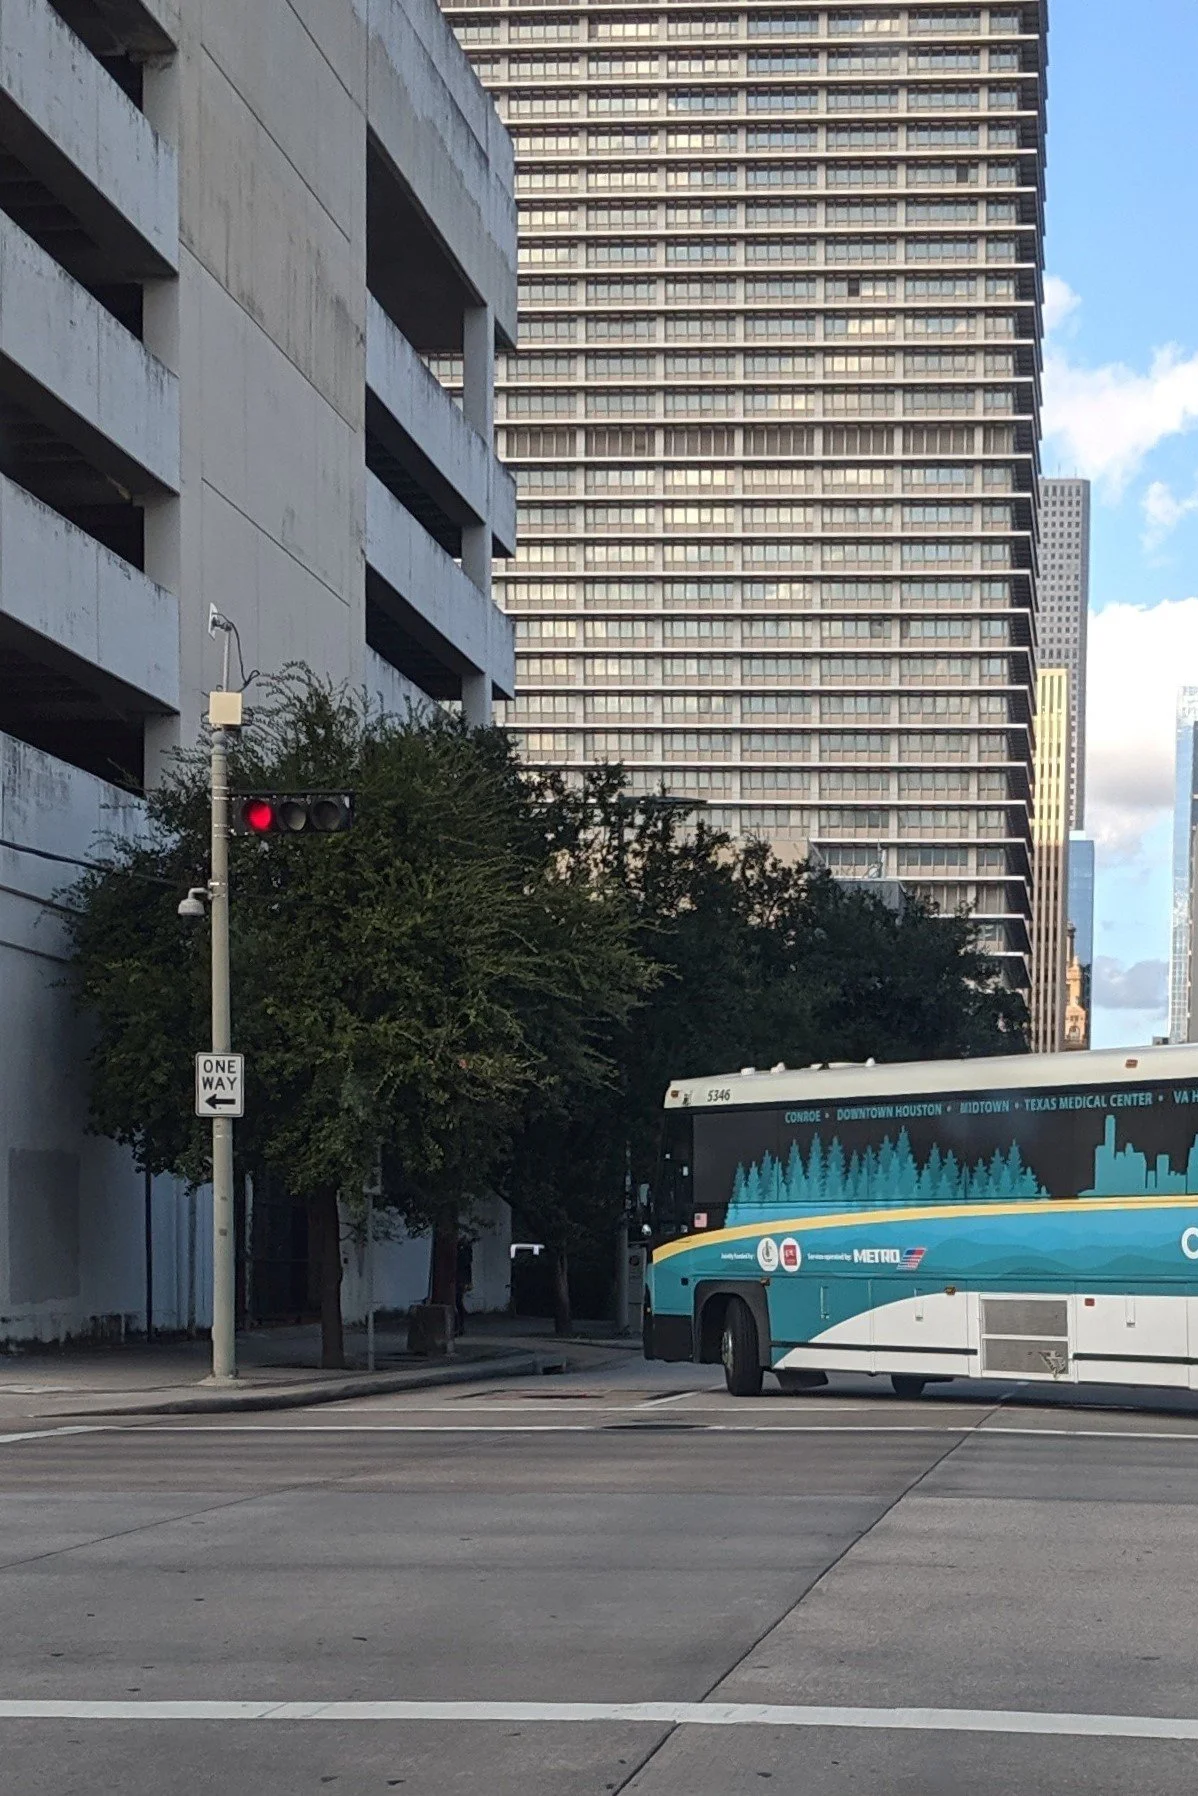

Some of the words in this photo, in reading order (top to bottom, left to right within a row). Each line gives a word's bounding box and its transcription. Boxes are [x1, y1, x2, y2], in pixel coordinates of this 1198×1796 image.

[203, 1059, 236, 1074] ONE
[201, 1076, 237, 1091] WAY
[707, 1088, 731, 1102] 5346
[784, 1110, 821, 1124] CONROE
[836, 1107, 893, 1121] DOWNTOWN
[895, 1104, 942, 1117] HOUSTON
[959, 1100, 1011, 1114] MIDTOWN
[1024, 1097, 1057, 1111] TEXAS
[1058, 1095, 1108, 1110] MEDICAL
[1110, 1092, 1153, 1107] CENTER
[1173, 1090, 1190, 1104] VA
[853, 1248, 900, 1264] METRO
